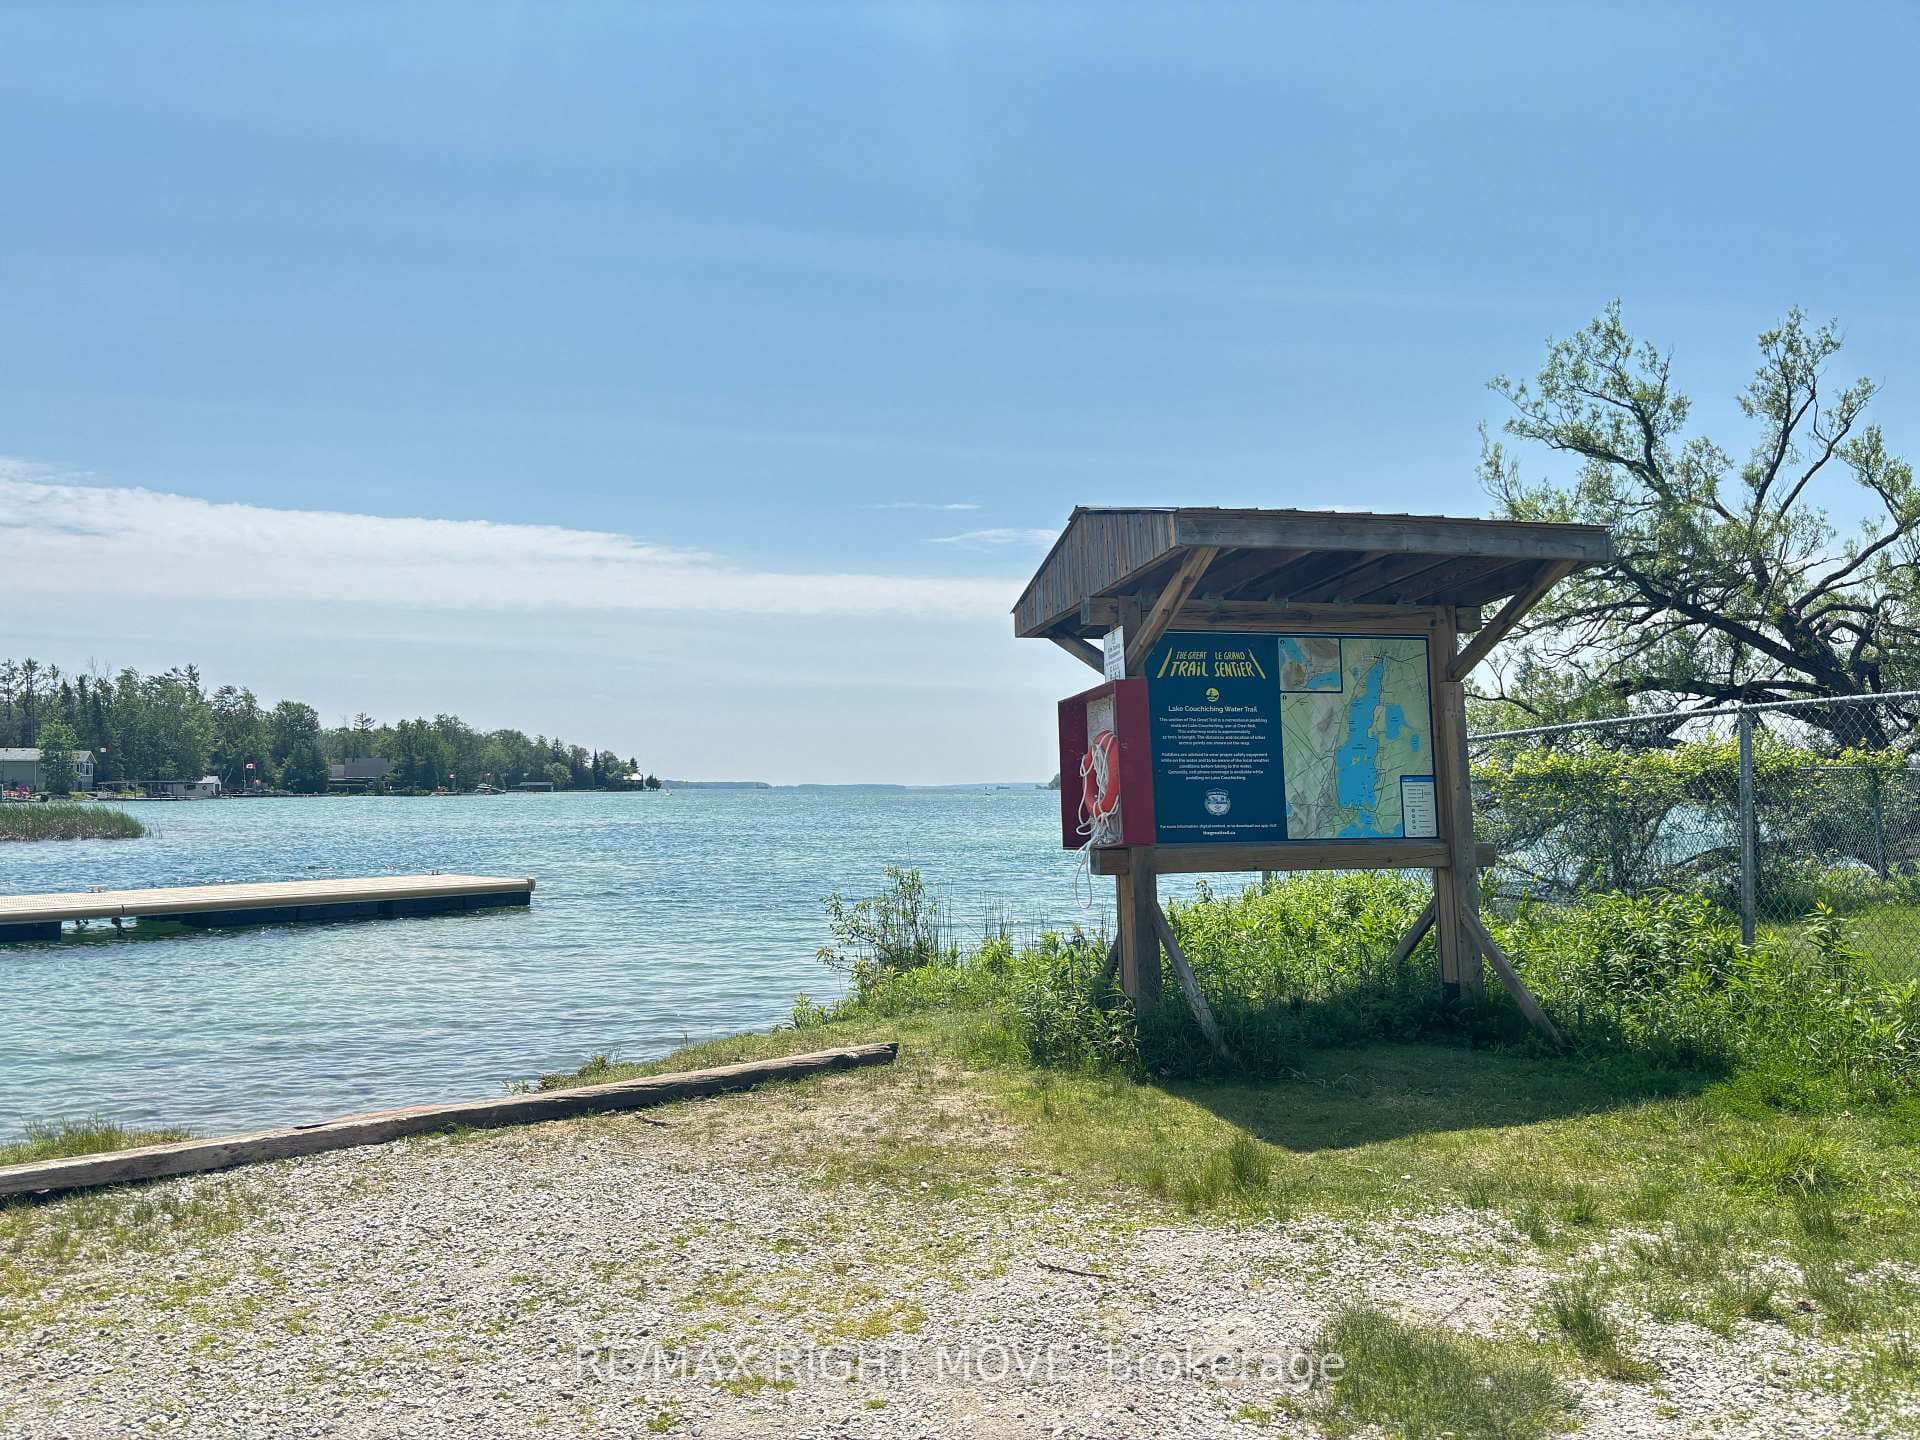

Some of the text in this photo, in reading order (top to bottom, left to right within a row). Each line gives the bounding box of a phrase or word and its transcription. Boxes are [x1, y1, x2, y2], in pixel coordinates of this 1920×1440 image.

[1176, 651, 1208, 660] THE GREAT
[1214, 651, 1246, 660] LE GRAND
[1184, 705, 1224, 714] Couchiching
[1224, 705, 1244, 713] Water
[1244, 705, 1258, 713] Trail
